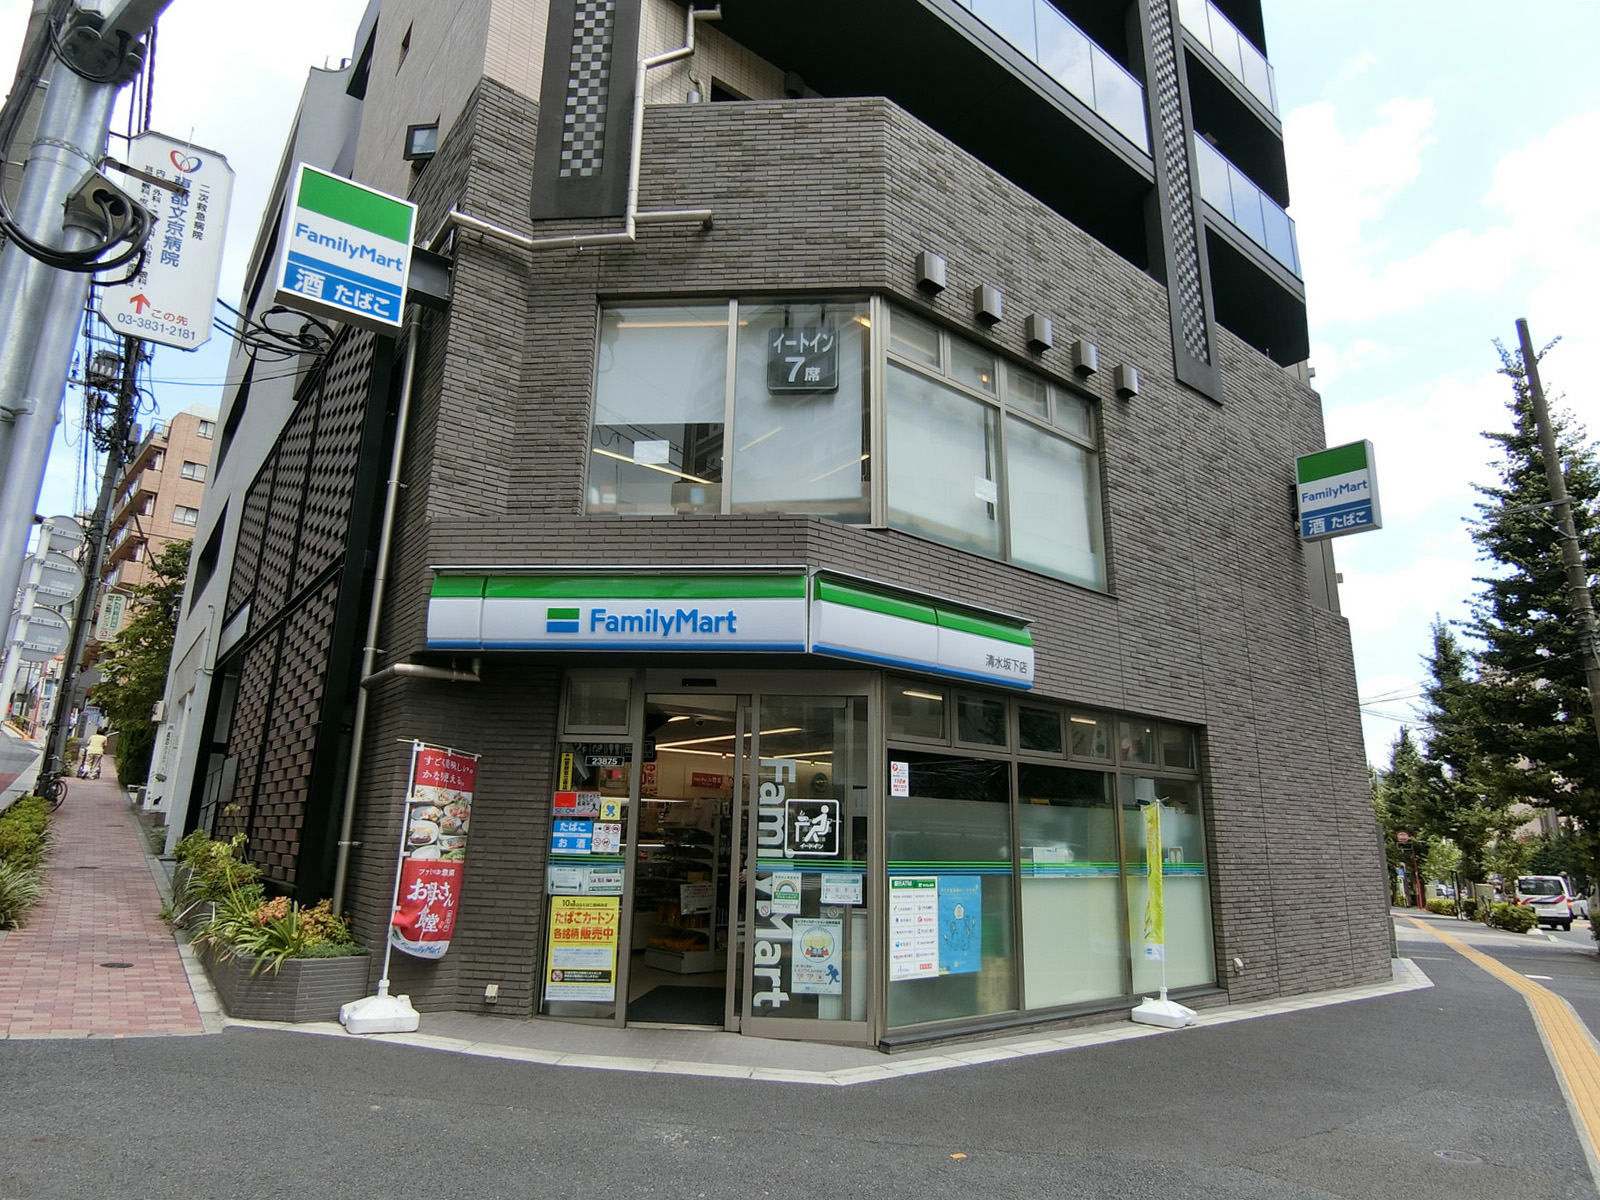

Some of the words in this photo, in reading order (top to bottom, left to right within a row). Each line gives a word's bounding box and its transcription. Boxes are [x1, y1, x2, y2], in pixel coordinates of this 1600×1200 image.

[192, 184, 210, 240] 二次救急病院
[295, 222, 403, 272] FamilyMart
[294, 268, 326, 299] 酒
[333, 284, 390, 317] たばこ
[117, 312, 196, 340] 03-3831-2181
[151, 309, 188, 326] この先
[773, 332, 834, 354] イートイン
[784, 356, 821, 383] 7席
[1301, 480, 1368, 503] FamilyMart
[1308, 517, 1326, 535] 酒
[1331, 511, 1367, 529] たばこ
[589, 607, 738, 637] FamilyMart
[985, 653, 1028, 674] 清水坂下店
[591, 757, 618, 766] 23875
[559, 821, 587, 832] たばこ
[406, 877, 454, 907] お母さん
[414, 904, 440, 933] 食堂
[554, 911, 615, 925] たばこカートン
[553, 926, 614, 941] 各銘柄販売中
